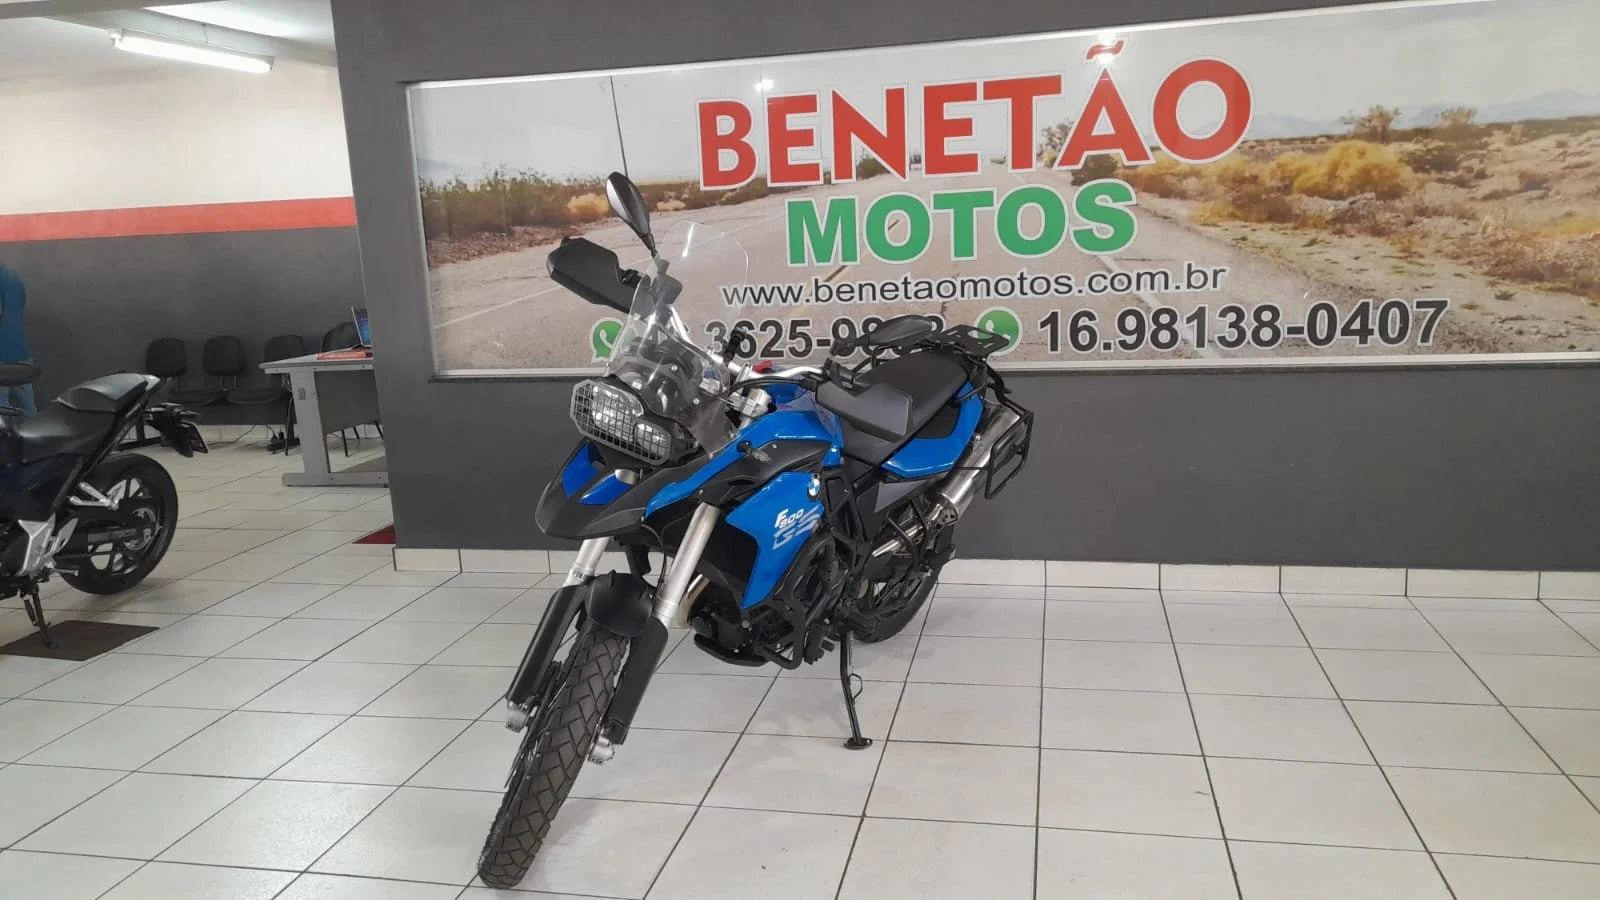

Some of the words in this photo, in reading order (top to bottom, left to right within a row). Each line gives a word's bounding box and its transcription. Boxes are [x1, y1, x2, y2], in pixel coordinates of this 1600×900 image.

[698, 39, 1252, 189] BENETÃO
[787, 181, 1136, 264] MOTOS
[723, 263, 1227, 305] www.benetaomotos.com.br
[1039, 299, 1448, 353] 16.98138-0407
